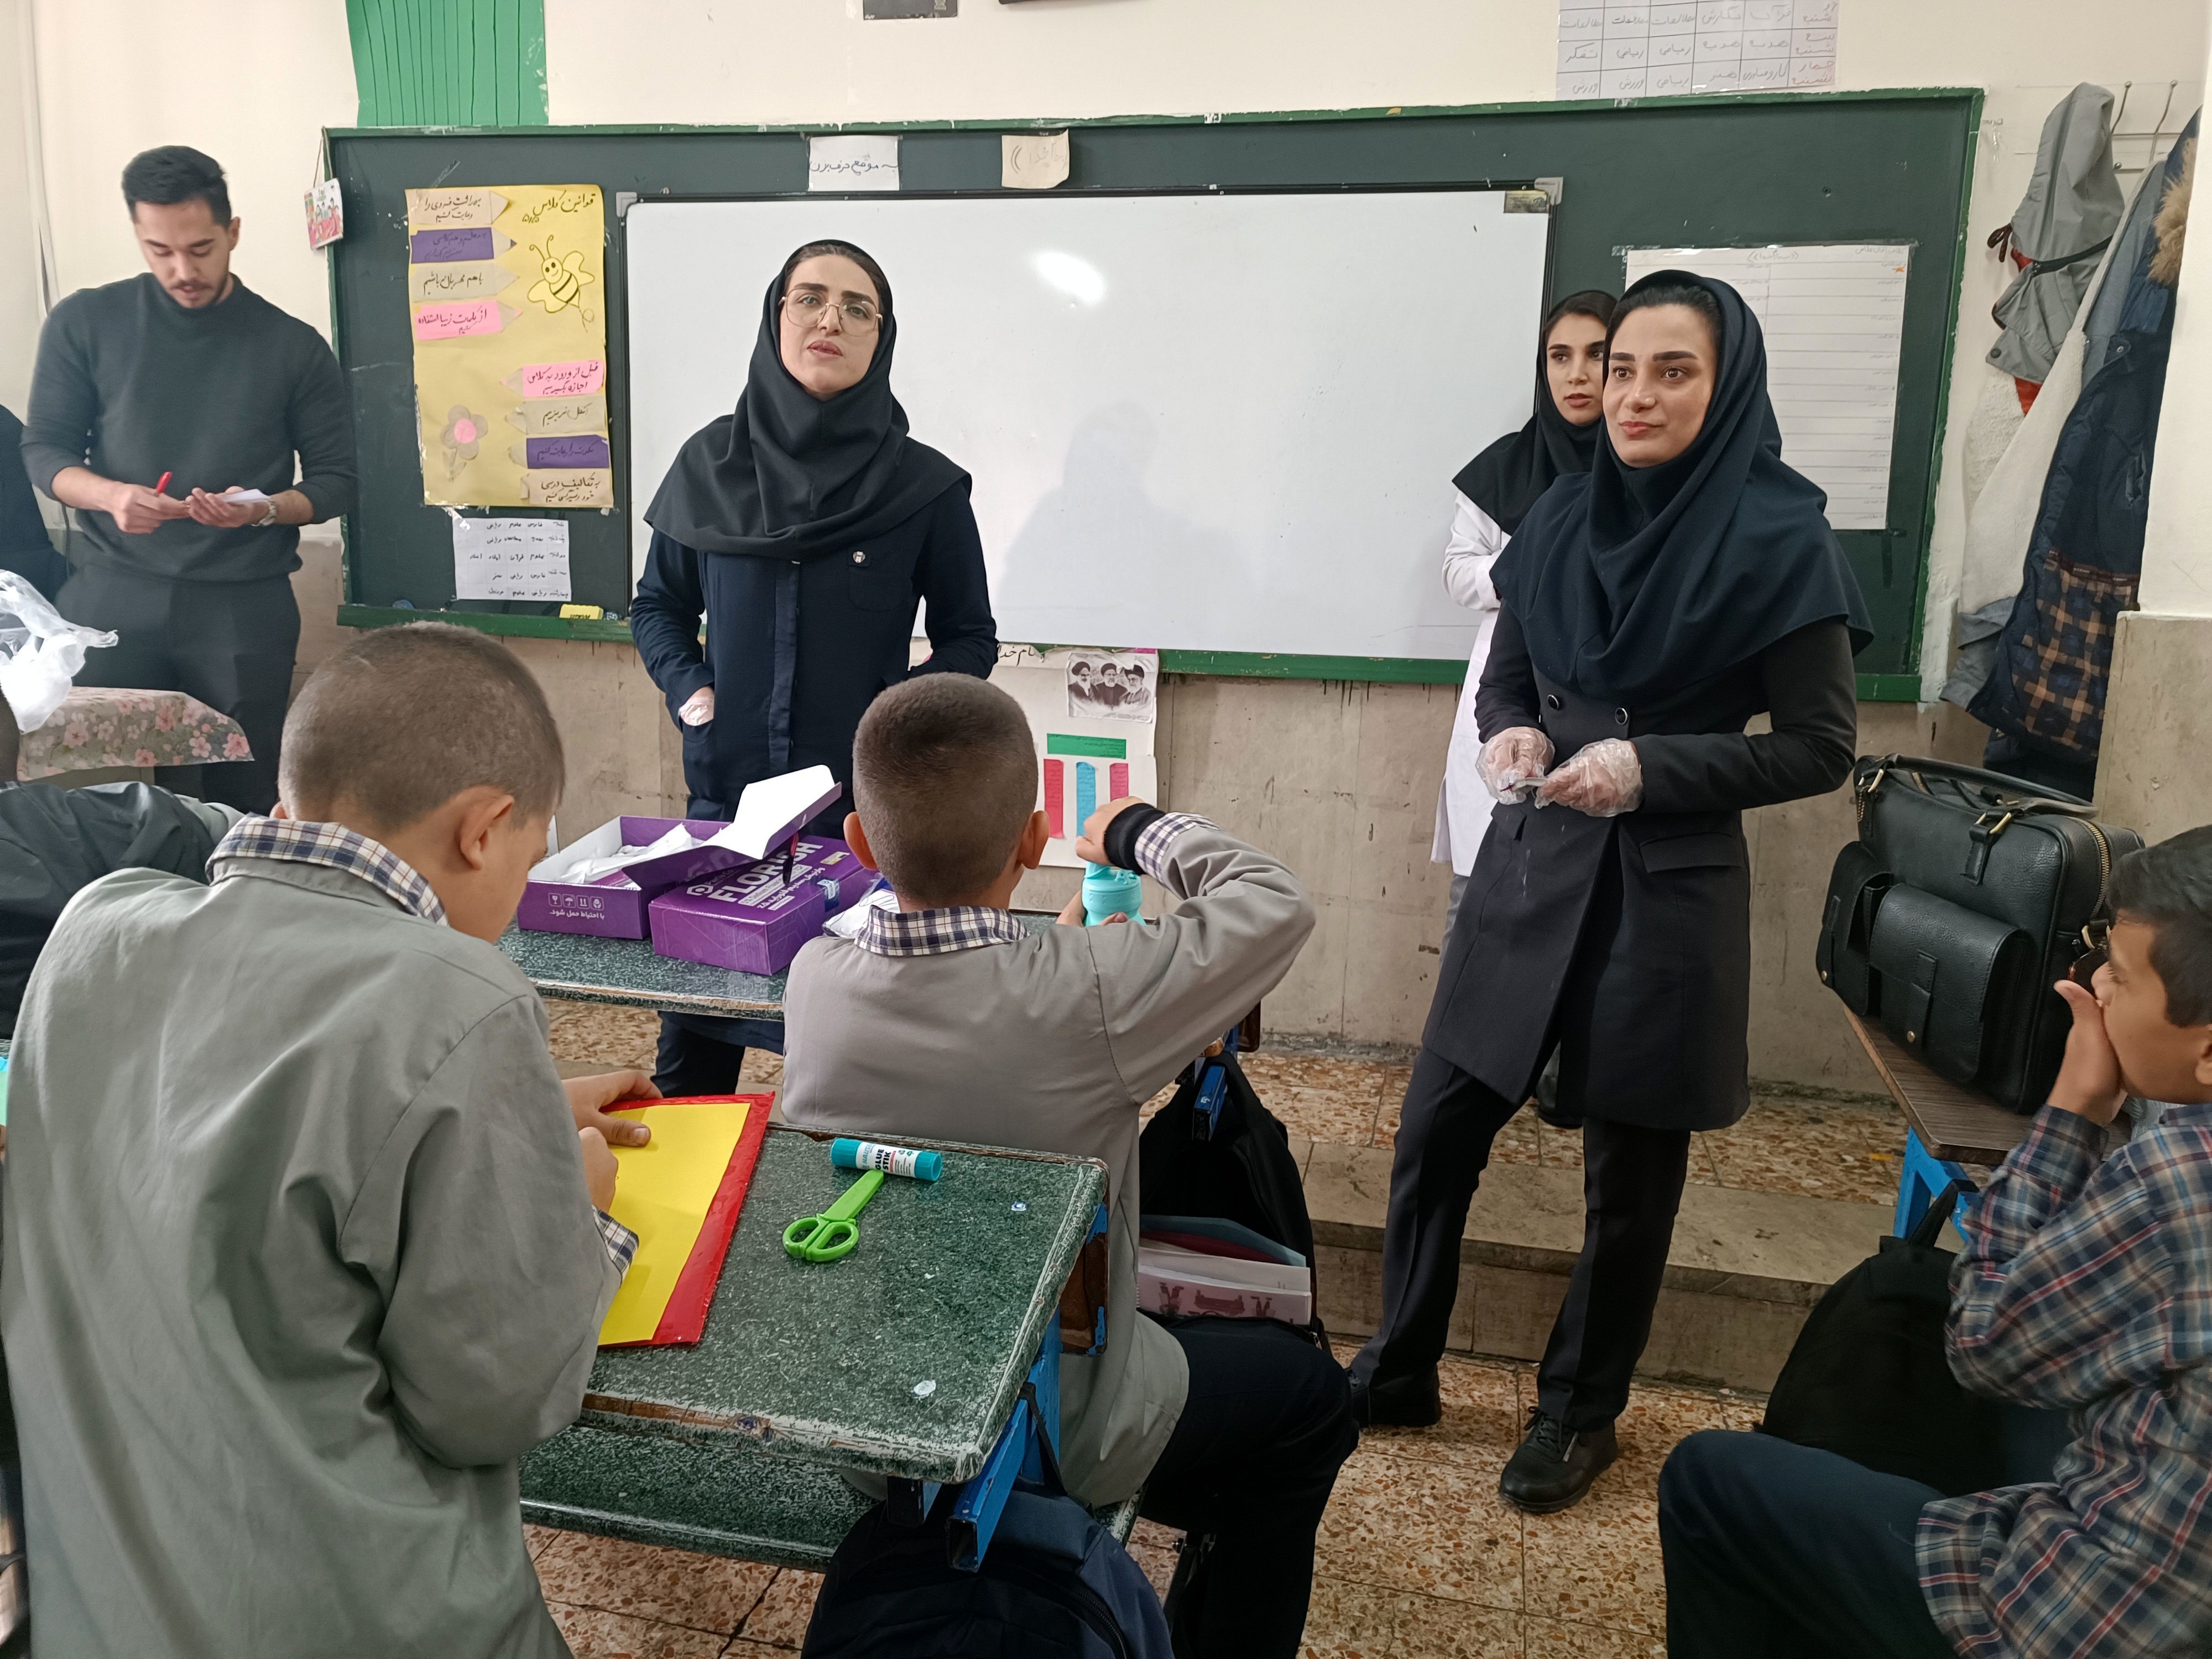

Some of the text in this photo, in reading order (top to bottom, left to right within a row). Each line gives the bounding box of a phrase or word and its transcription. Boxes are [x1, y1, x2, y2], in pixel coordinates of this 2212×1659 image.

[1566, 39, 1789, 63] هدیه هدیه ریاضی ریاضی تفکر
[1573, 79, 1598, 93] ورزش
[1620, 75, 1645, 89] ورزش
[1657, 75, 1689, 88] ریاضی
[830, 160, 850, 173] حرف
[851, 158, 879, 176] موقع
[881, 164, 898, 173] به
[533, 189, 596, 216] قوانین کلاس
[418, 305, 487, 327] از کلمات زیبا استفاده
[527, 366, 552, 384] کلاس
[554, 371, 572, 380] ورود
[581, 362, 598, 378] قبل
[568, 381, 588, 393] اجازه
[541, 481, 560, 490] درسی
[561, 472, 596, 490] تکالیف
[581, 491, 594, 501] خود
[707, 842, 823, 902] FLORISH
[566, 909, 580, 917] حمل
[581, 911, 599, 919] احتیاط
[599, 912, 605, 921] با
[875, 1149, 884, 1170] GLUE
[882, 1151, 891, 1170] STIK
